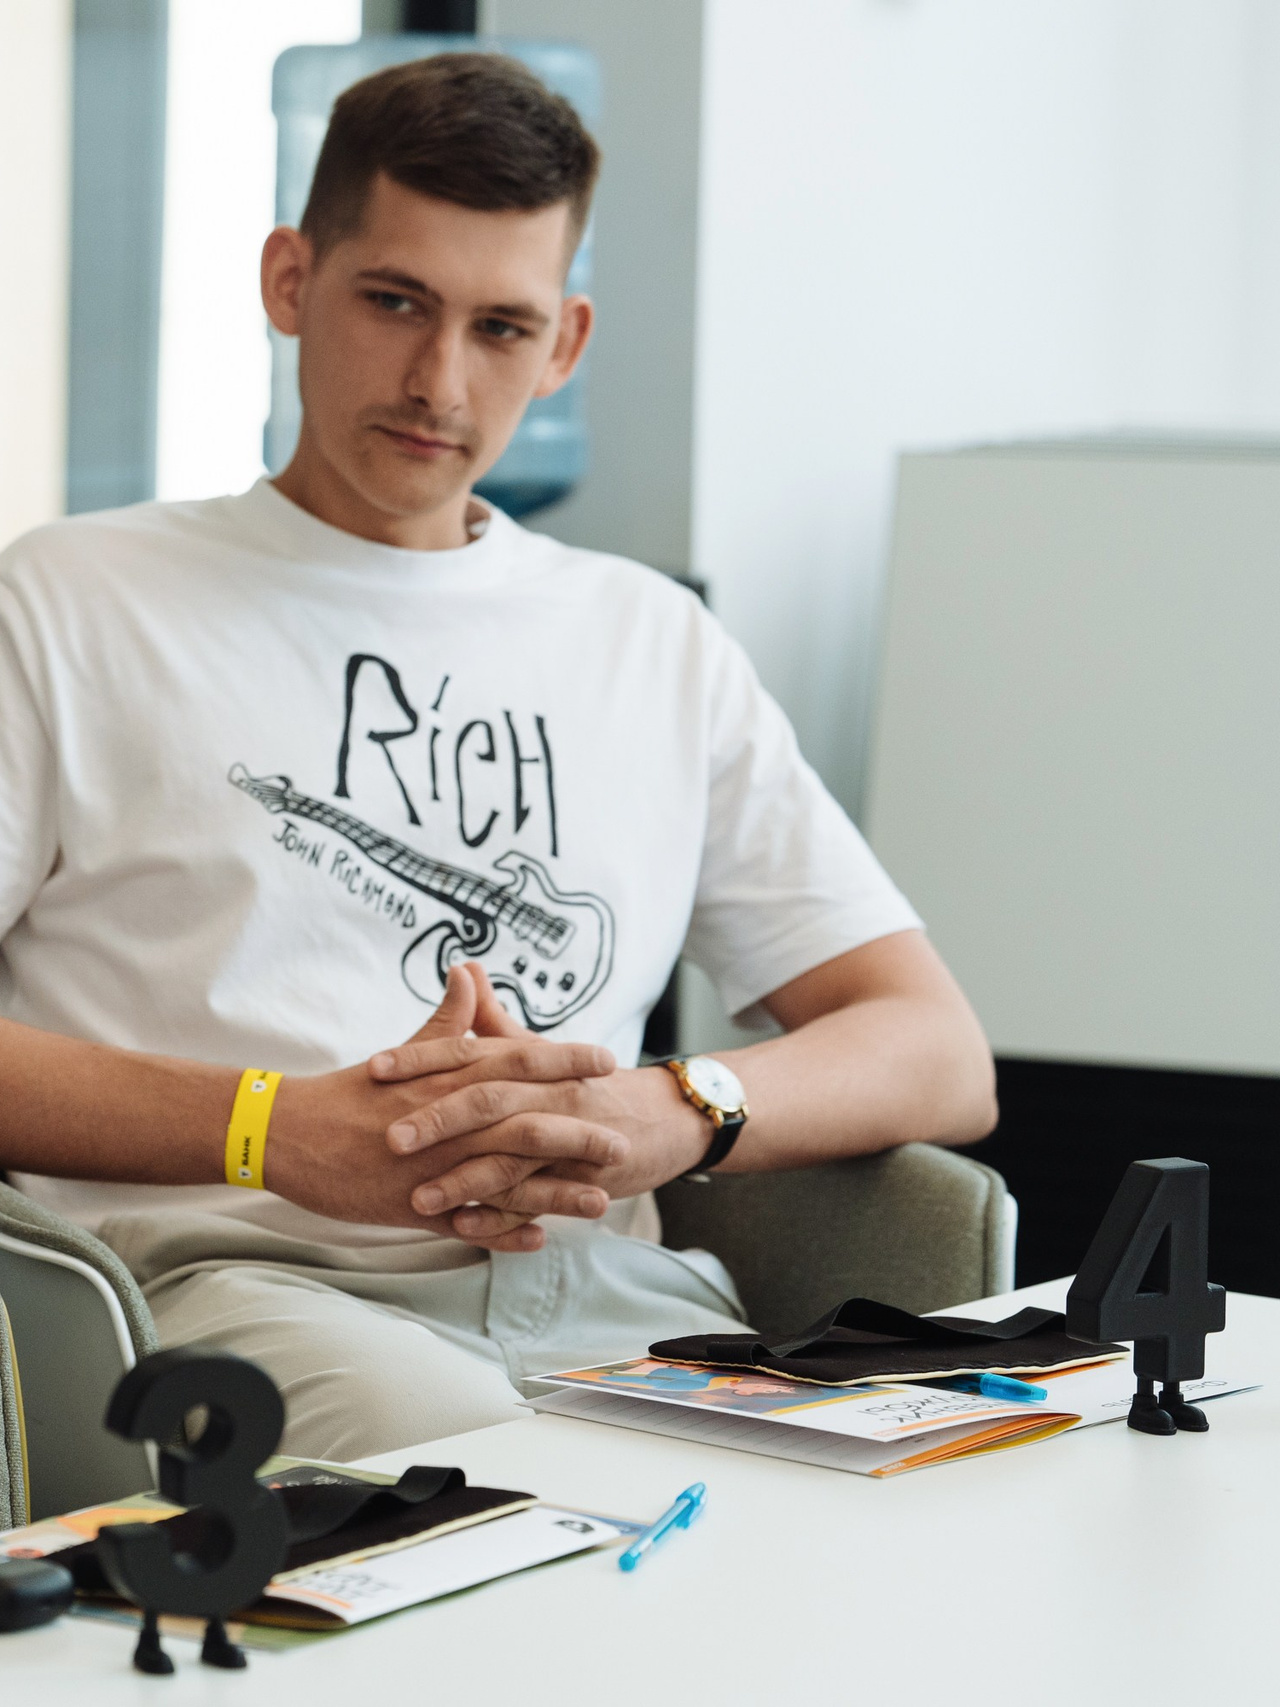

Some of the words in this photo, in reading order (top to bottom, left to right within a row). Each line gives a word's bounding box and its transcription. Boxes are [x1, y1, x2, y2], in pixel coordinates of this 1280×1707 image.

[272, 819, 326, 867] JOHN
[1066, 1157, 1226, 1383] 4
[99, 1353, 290, 1620] 3
